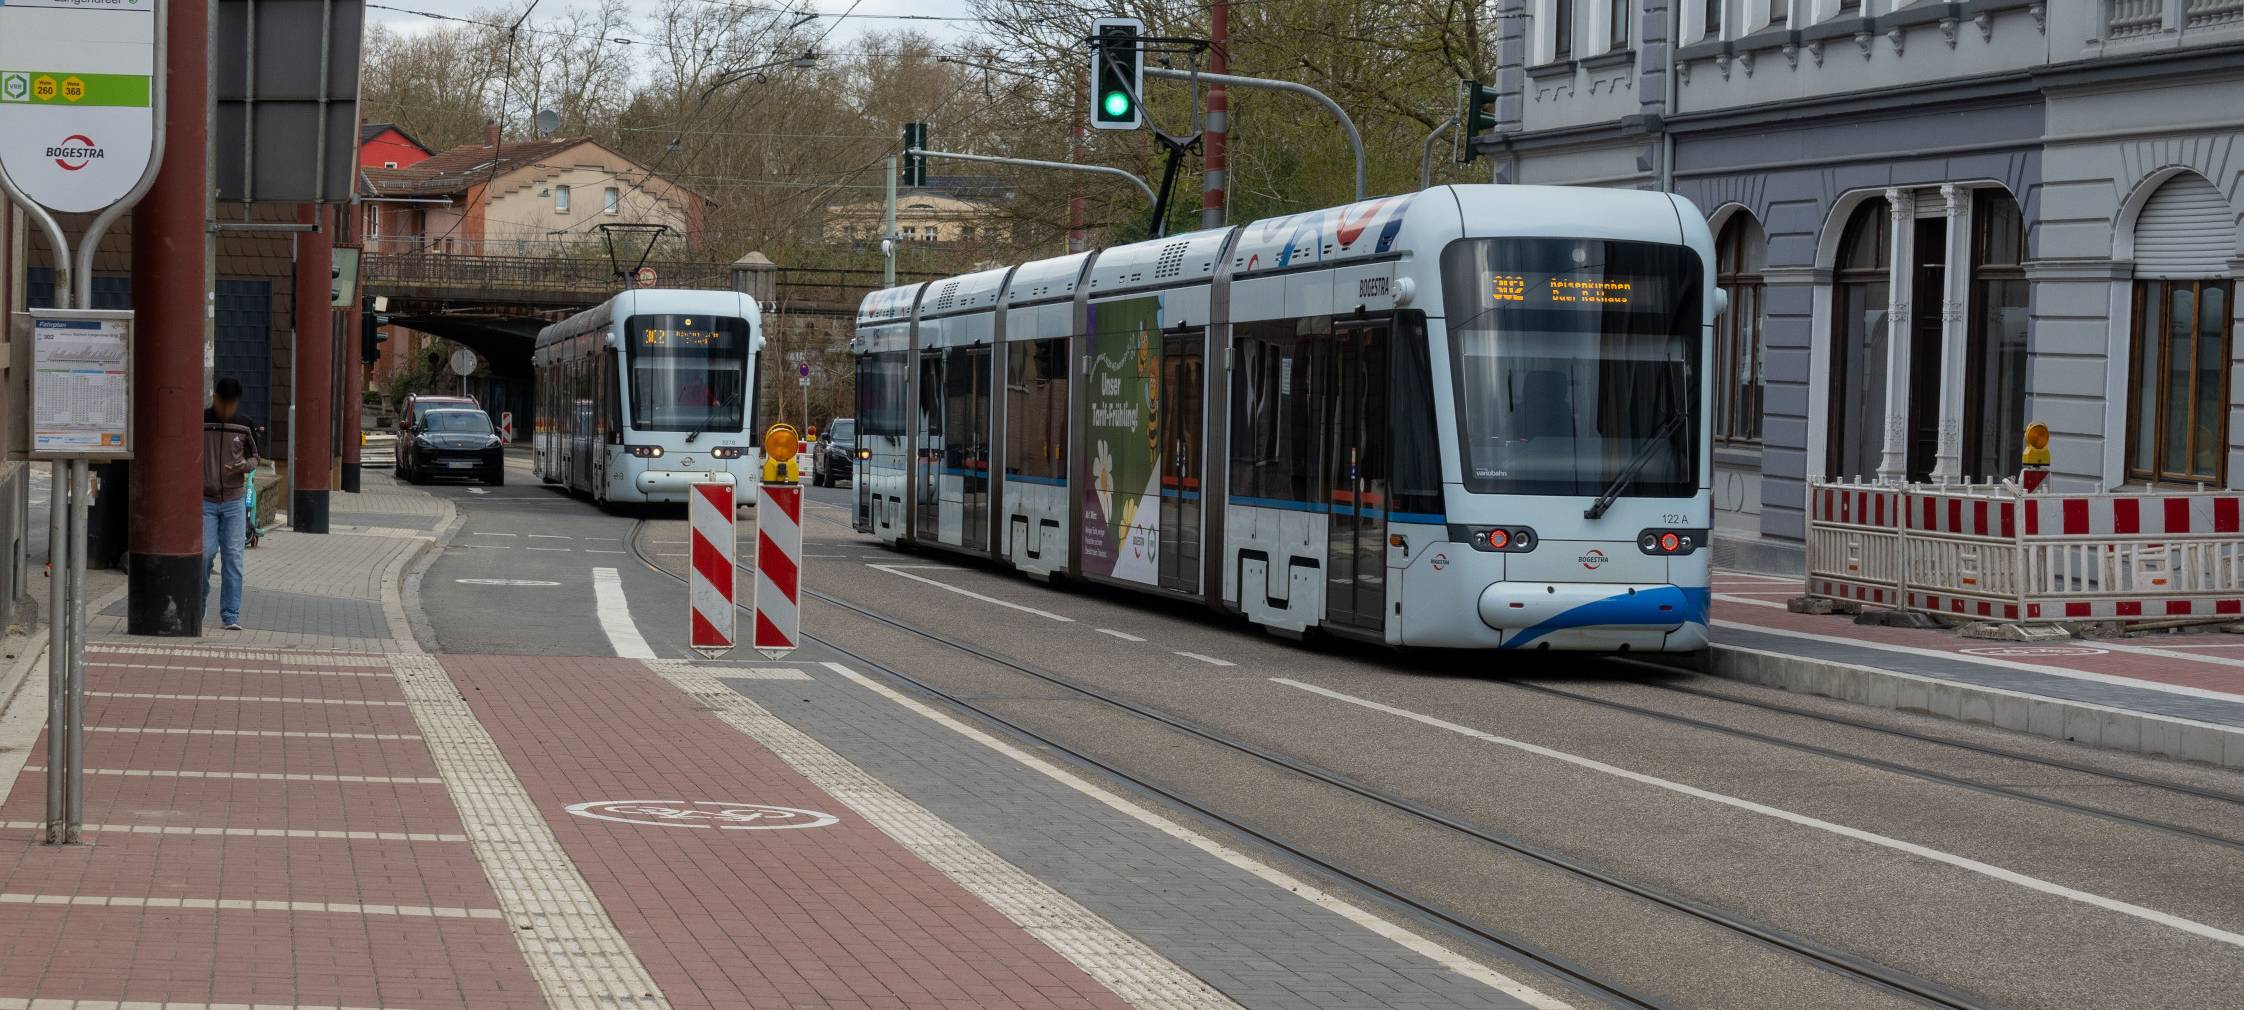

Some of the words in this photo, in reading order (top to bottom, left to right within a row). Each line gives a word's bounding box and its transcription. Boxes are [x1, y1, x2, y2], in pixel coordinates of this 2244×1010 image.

[37, 86, 53, 95] 260
[66, 87, 81, 96] 368
[46, 147, 105, 159] BOGESTRA
[1359, 276, 1389, 298] BOGESTRA
[1101, 371, 1121, 396] Unser
[1662, 514, 1680, 524] 122
[1681, 514, 1689, 524] A
